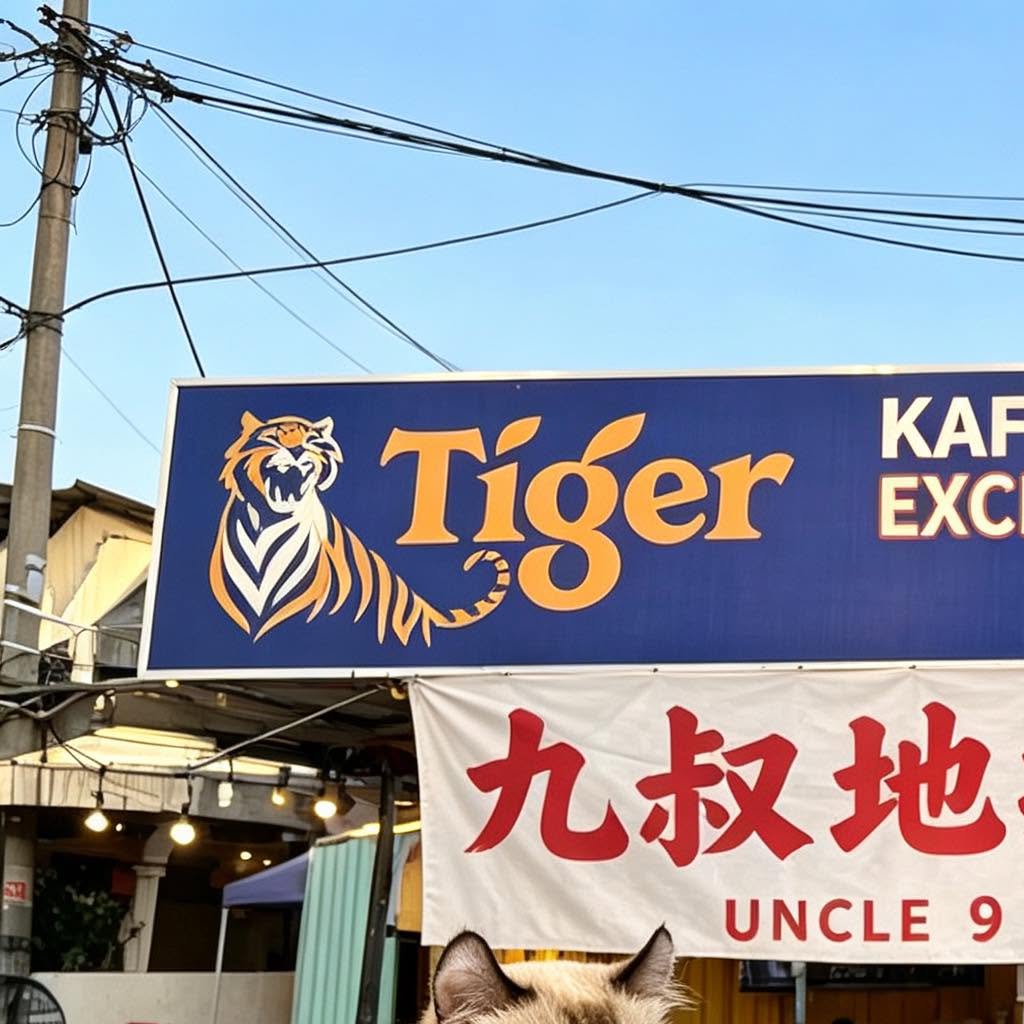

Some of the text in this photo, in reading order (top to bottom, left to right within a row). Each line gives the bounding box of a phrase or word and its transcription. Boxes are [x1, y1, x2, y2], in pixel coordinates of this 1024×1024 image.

[380, 413, 793, 612] Tiger
[725, 896, 929, 943] UNCLE
[969, 897, 1003, 942] 9
